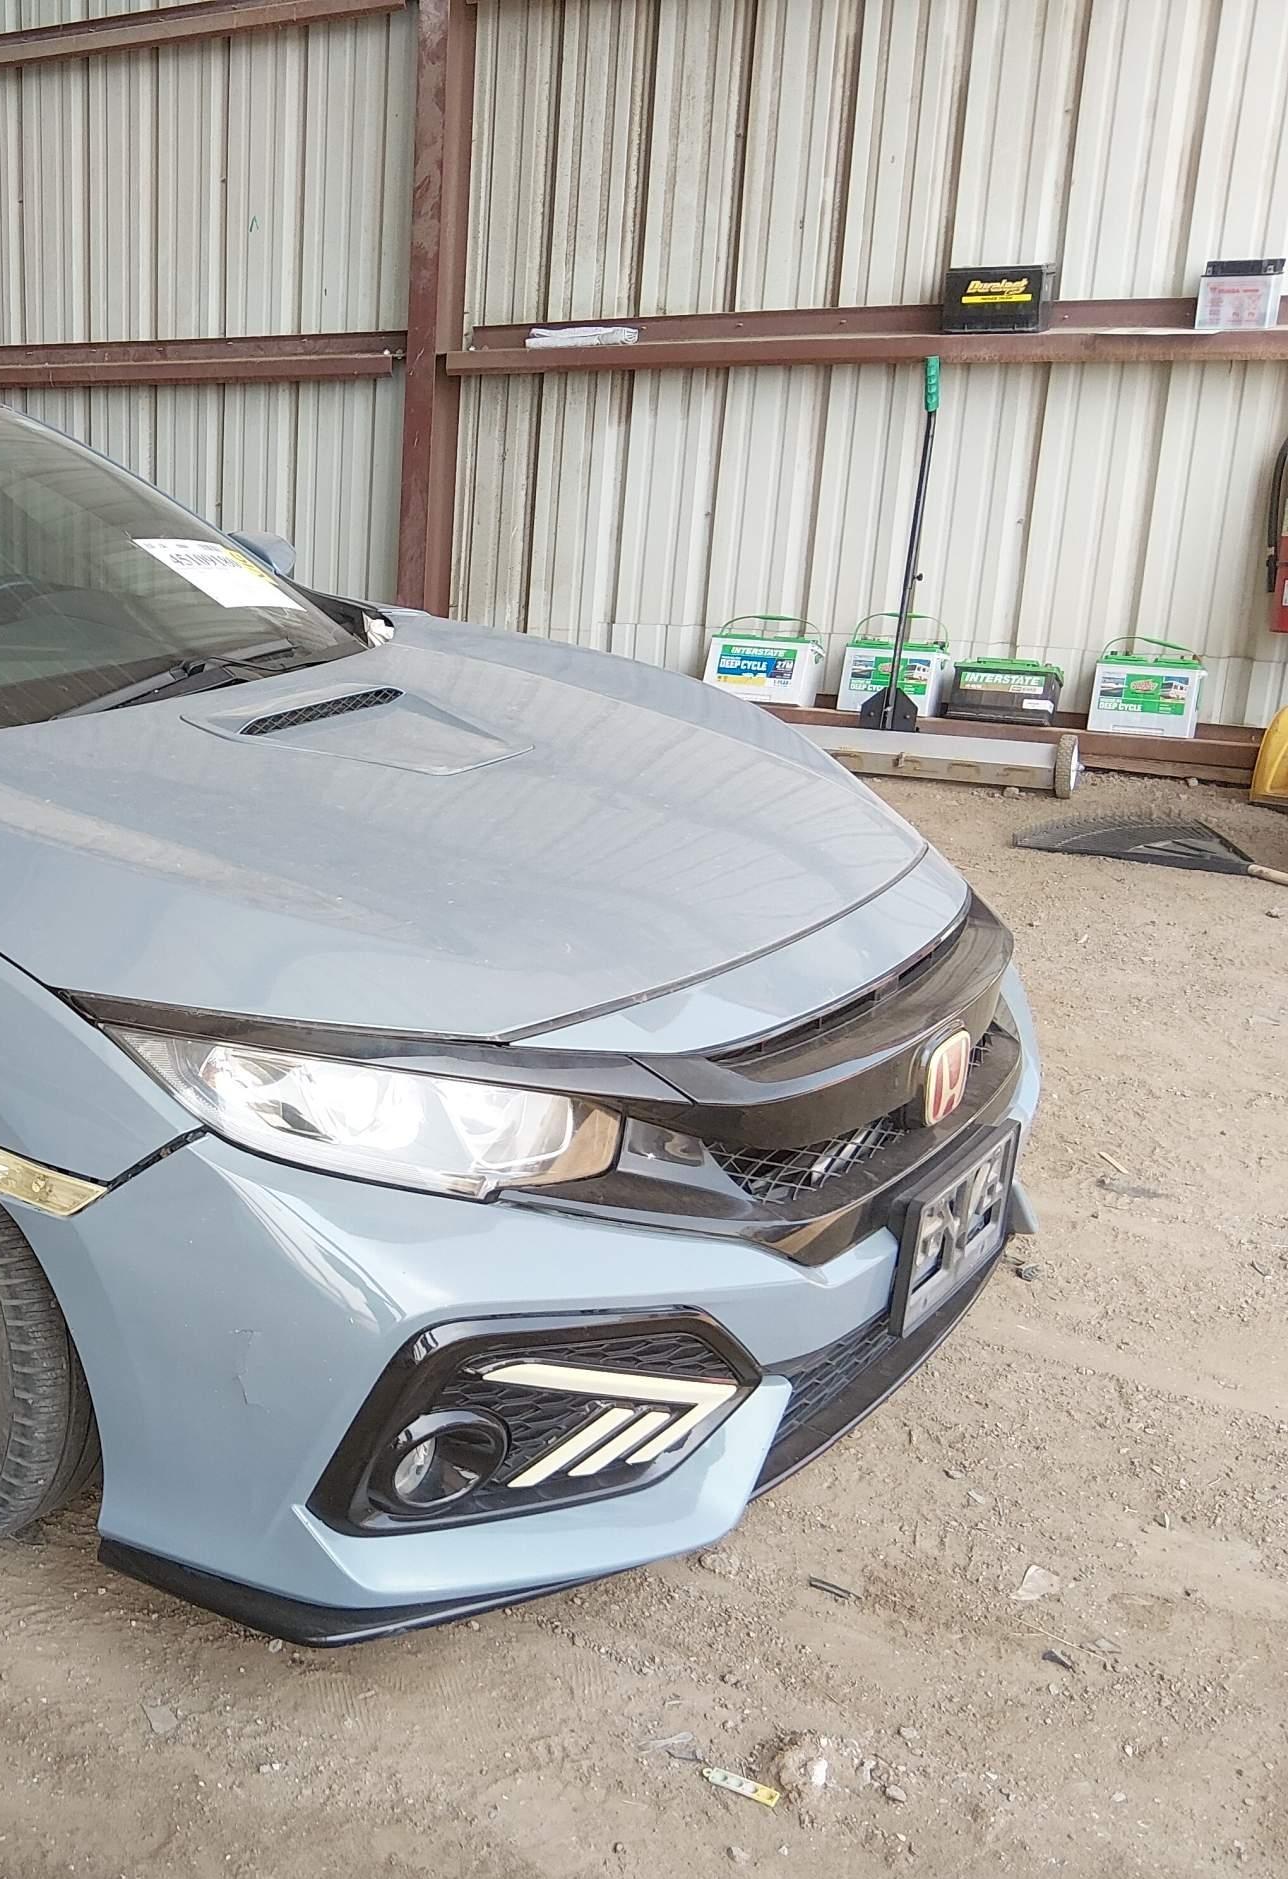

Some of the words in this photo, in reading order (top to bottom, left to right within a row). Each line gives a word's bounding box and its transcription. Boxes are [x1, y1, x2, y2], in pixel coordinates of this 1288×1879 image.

[966, 278, 1029, 295] Duralast
[730, 646, 787, 657] INTERSTATE
[720, 658, 740, 669] DEEP
[740, 660, 768, 671] CYCLE
[965, 671, 1041, 686] INTERSTATE
[850, 683, 867, 691] DEEP
[1099, 701, 1117, 710] DEEP
[1118, 703, 1142, 712] CYCLE
